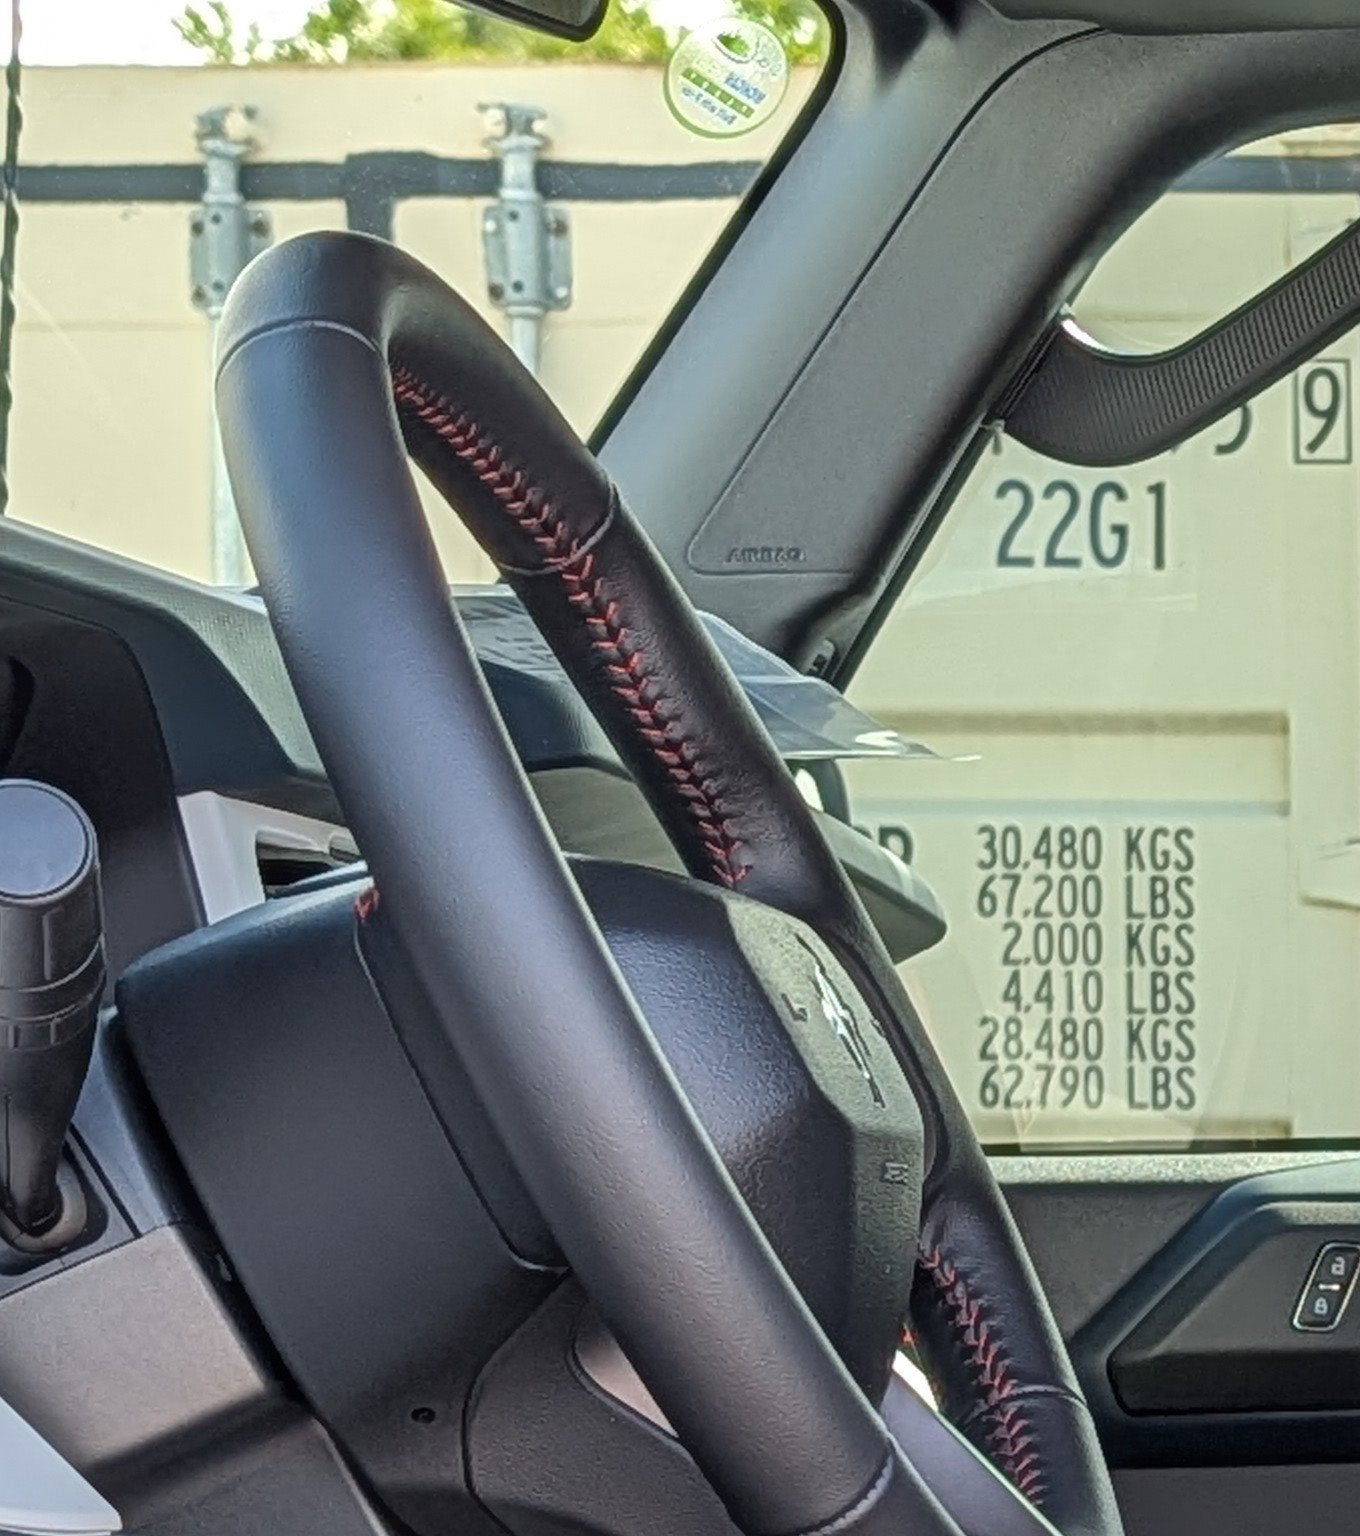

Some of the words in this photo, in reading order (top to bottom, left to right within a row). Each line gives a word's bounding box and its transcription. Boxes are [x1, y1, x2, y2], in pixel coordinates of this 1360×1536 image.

[1302, 367, 1343, 455] 9
[994, 478, 1168, 571] 22G1
[1124, 825, 1197, 872] KGS
[1124, 875, 1197, 920] LBS
[1125, 923, 1197, 968] KGS
[1125, 970, 1197, 1016] LBS
[1126, 1018, 1198, 1063] KGS
[1126, 1065, 1198, 1110] LBS
